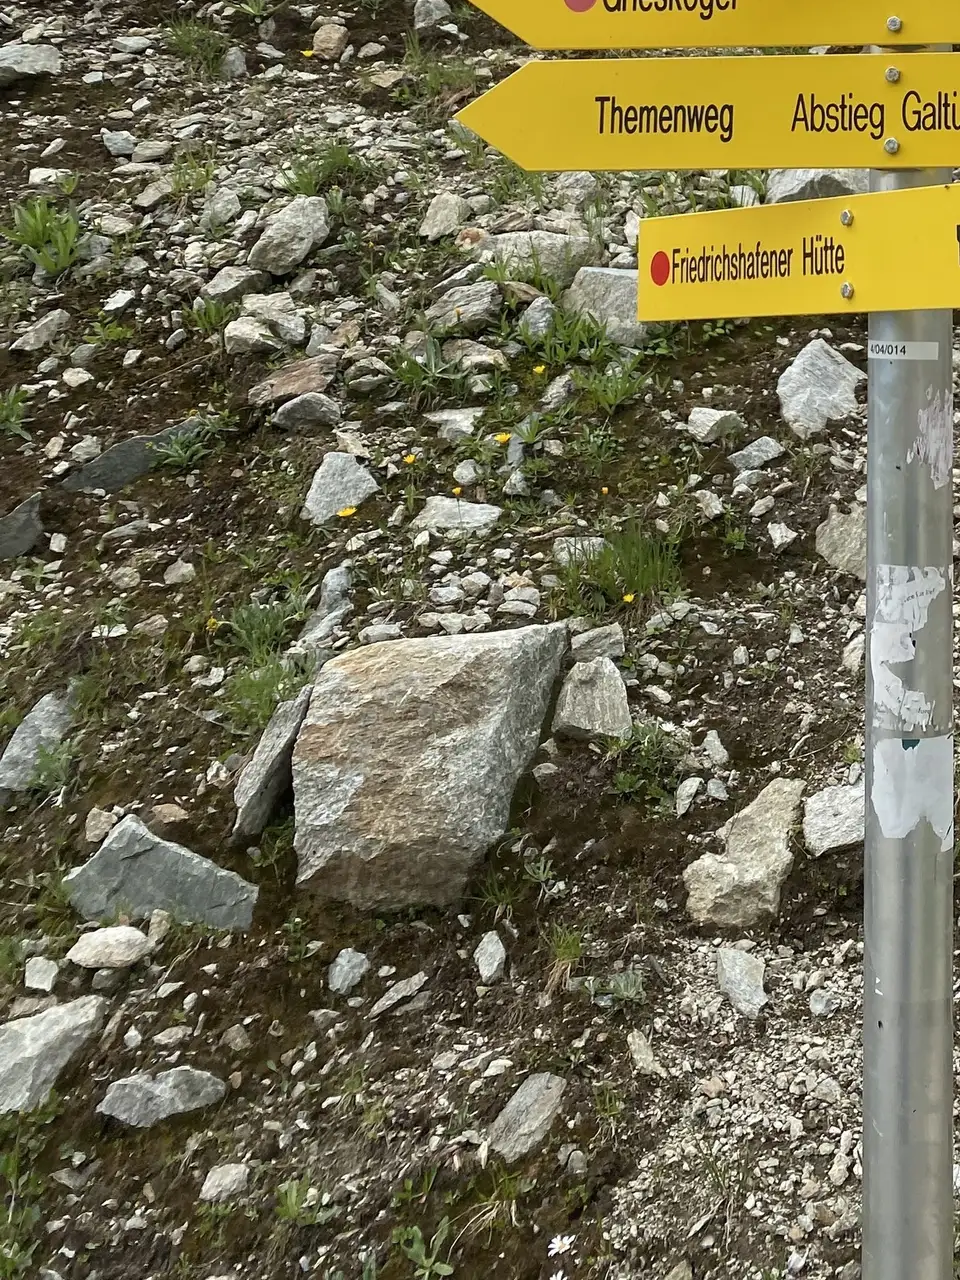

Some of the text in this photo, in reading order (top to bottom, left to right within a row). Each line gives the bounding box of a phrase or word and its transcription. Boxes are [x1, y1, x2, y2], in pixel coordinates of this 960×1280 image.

[594, 96, 734, 143] Themenweg
[791, 92, 885, 140] Abstieg
[672, 241, 793, 284] Friedrichshafener
[802, 234, 845, 276] Hütte
